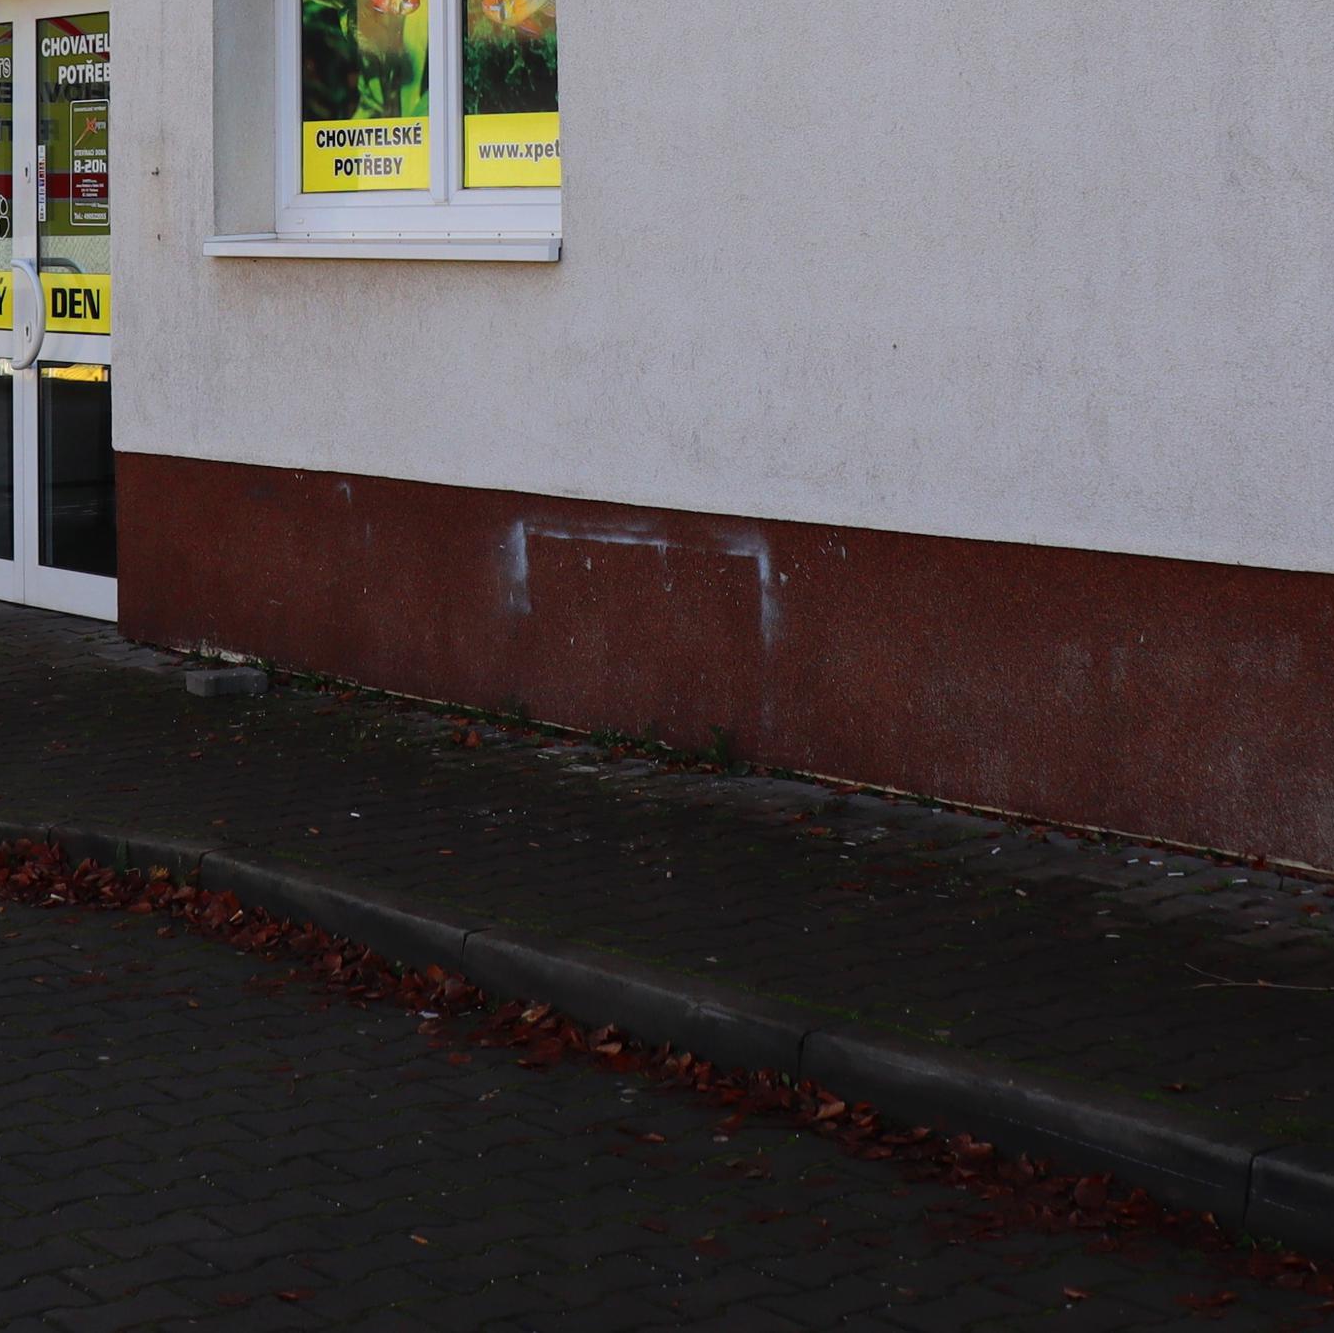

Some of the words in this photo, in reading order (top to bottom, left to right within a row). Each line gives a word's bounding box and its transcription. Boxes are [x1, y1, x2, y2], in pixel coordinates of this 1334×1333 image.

[316, 122, 422, 148] CHOVATELSKÉ
[74, 159, 107, 173] 8-20h
[334, 154, 403, 176] POTŘEBY
[51, 287, 101, 320] DEN
